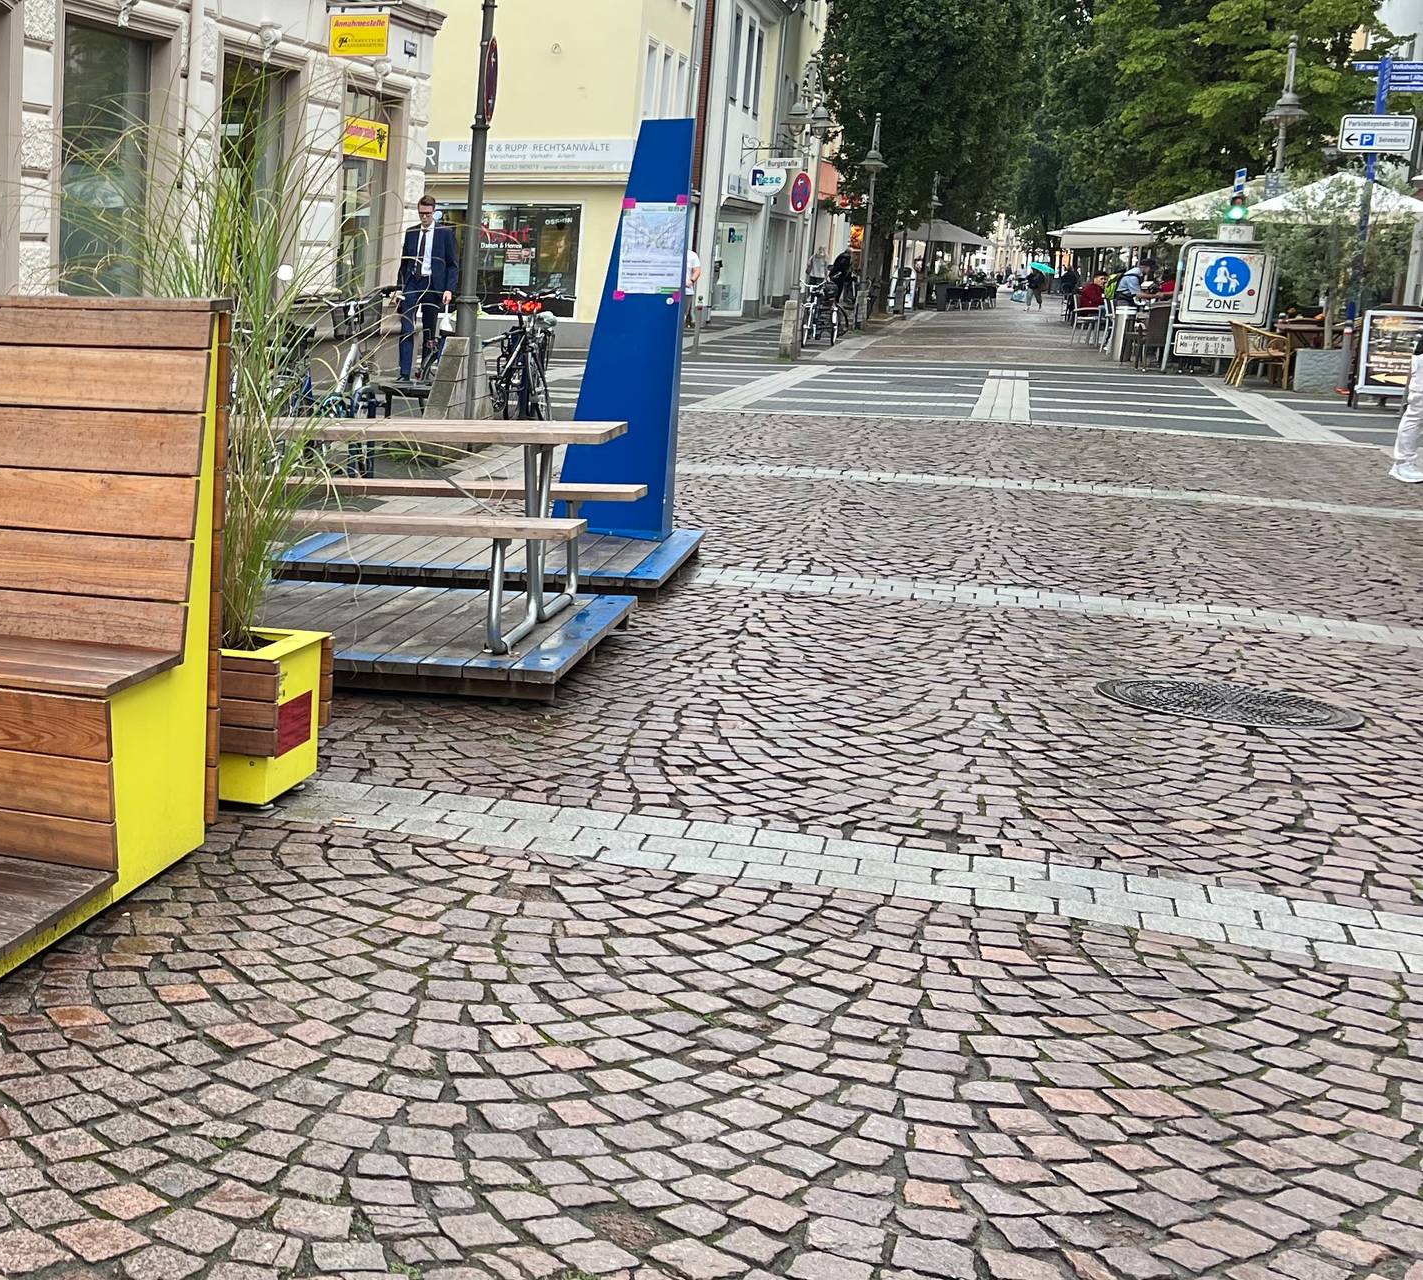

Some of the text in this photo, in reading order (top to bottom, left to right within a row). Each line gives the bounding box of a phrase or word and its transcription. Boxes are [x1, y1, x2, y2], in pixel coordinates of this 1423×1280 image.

[334, 19, 386, 28] Annahmestelle
[1363, 135, 1372, 145] P
[505, 144, 528, 152] RUPP
[533, 142, 610, 152] RECHTSANWÄLTE
[751, 169, 782, 186] Riese
[1205, 298, 1241, 310] ZONE
